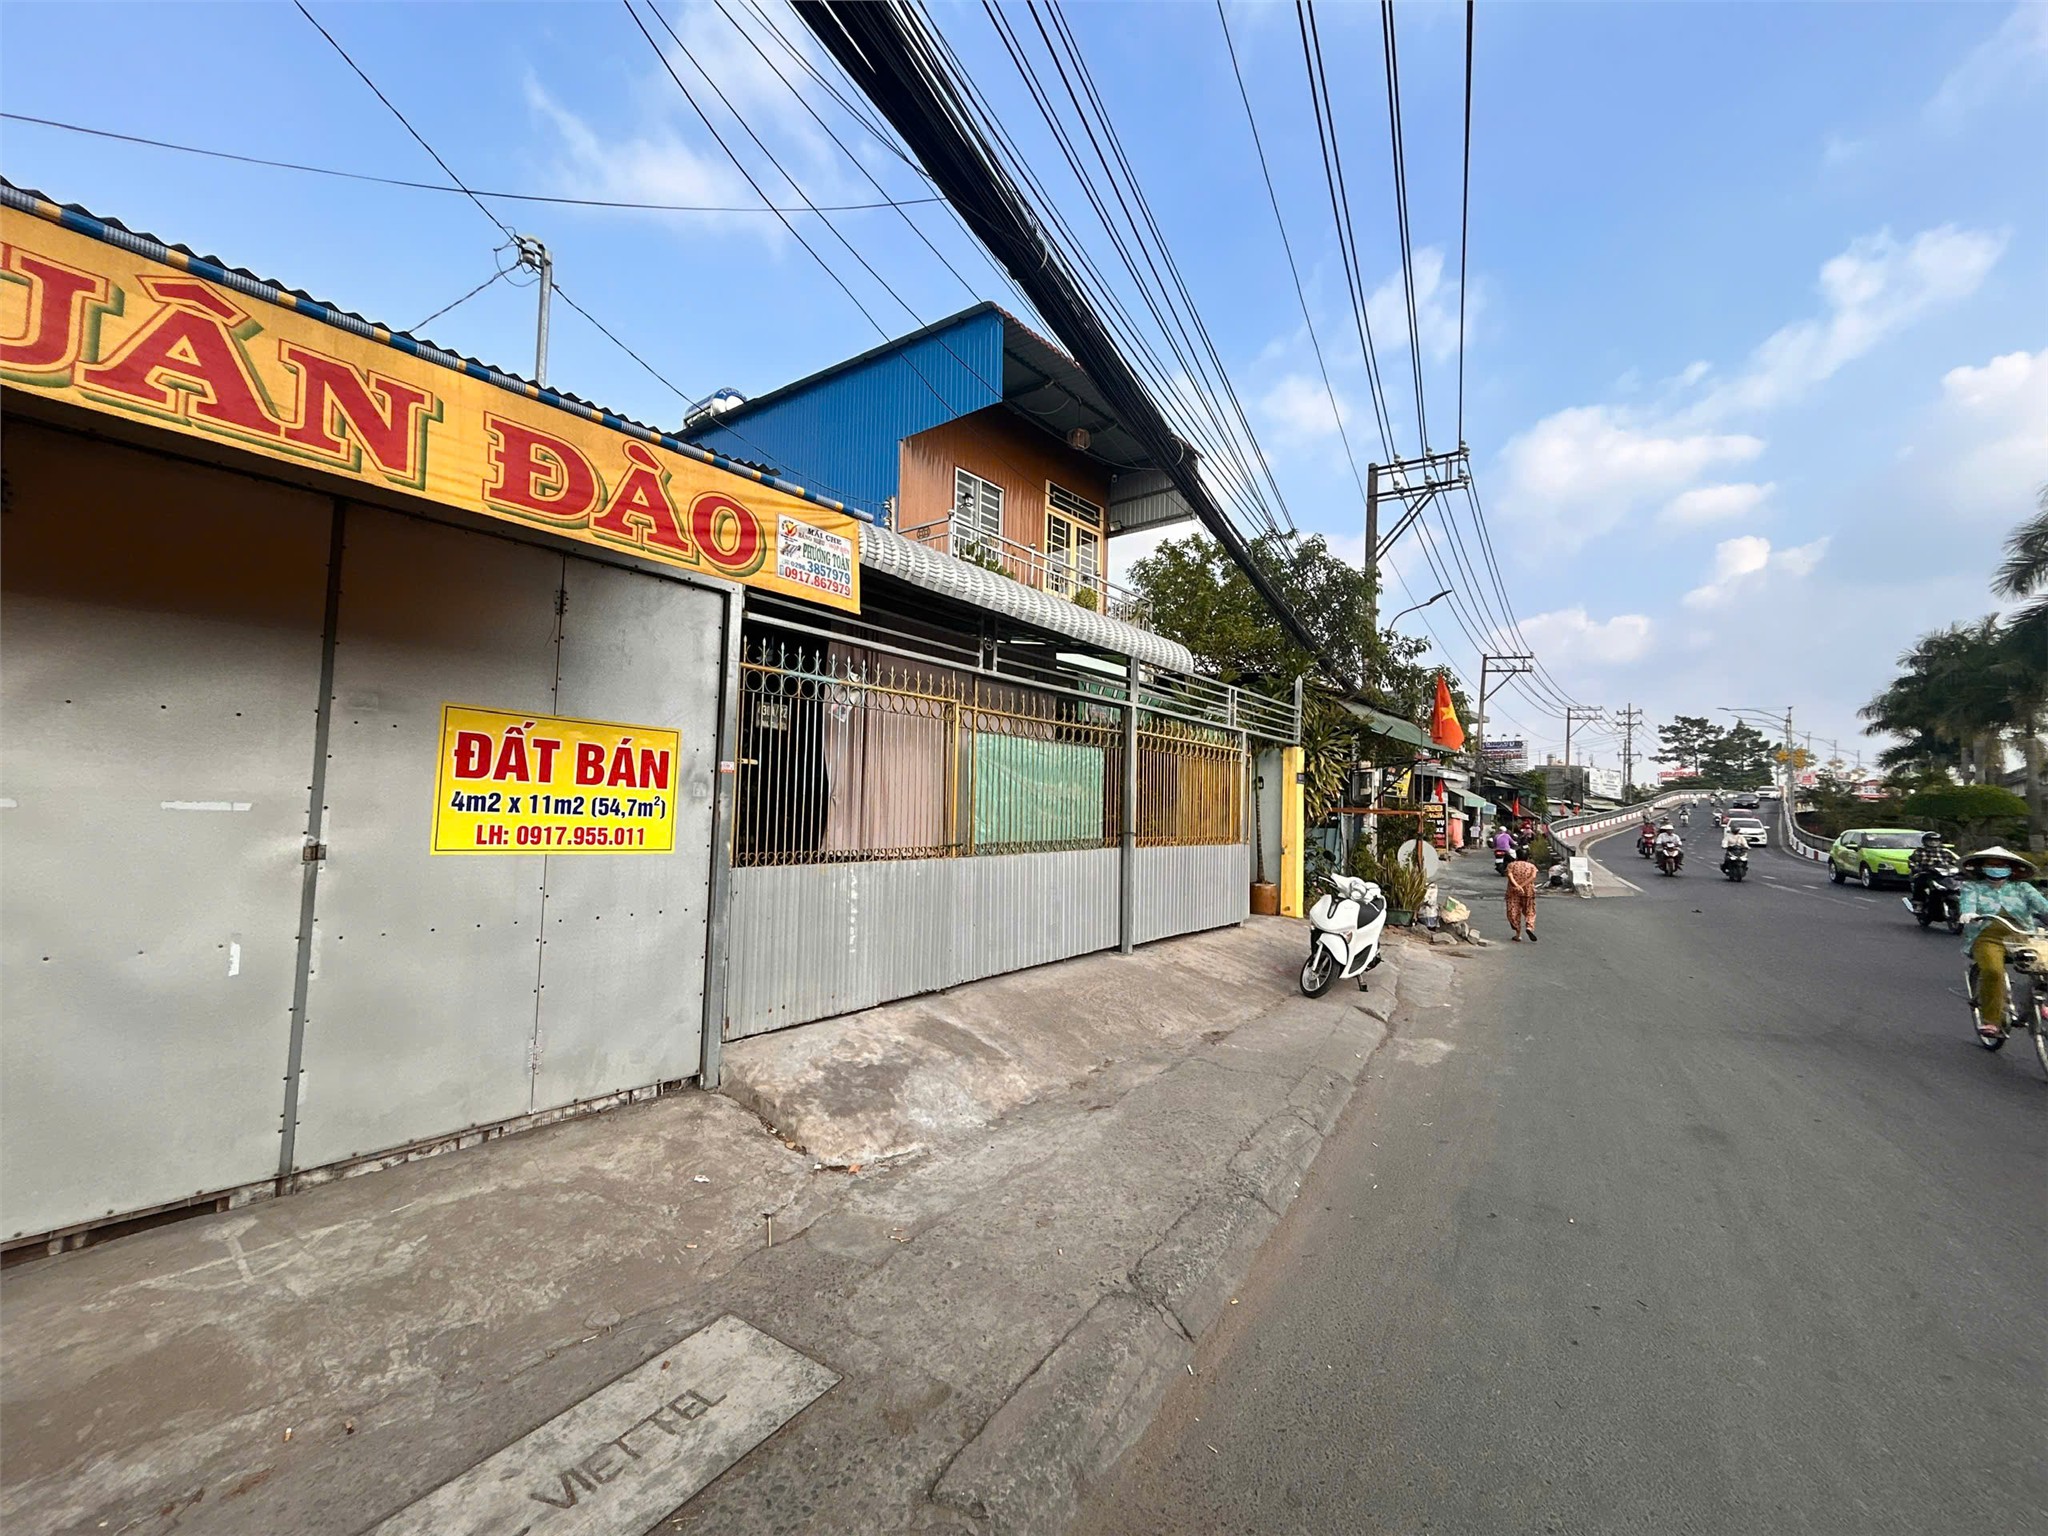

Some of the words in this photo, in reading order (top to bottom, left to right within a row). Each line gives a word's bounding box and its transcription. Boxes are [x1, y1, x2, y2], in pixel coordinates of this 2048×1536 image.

[481, 411, 764, 572] ĐÀO
[785, 566, 851, 596] 0917.867979
[807, 561, 850, 585] 3857979
[454, 721, 561, 783] ĐẤT
[576, 738, 670, 789] BÁN
[451, 791, 502, 812] 4m2
[508, 795, 521, 813] x
[529, 795, 584, 815] 11m2
[476, 825, 509, 845] LH:
[516, 825, 645, 846] 0917.955.011
[530, 1389, 727, 1509] VIETTEL
